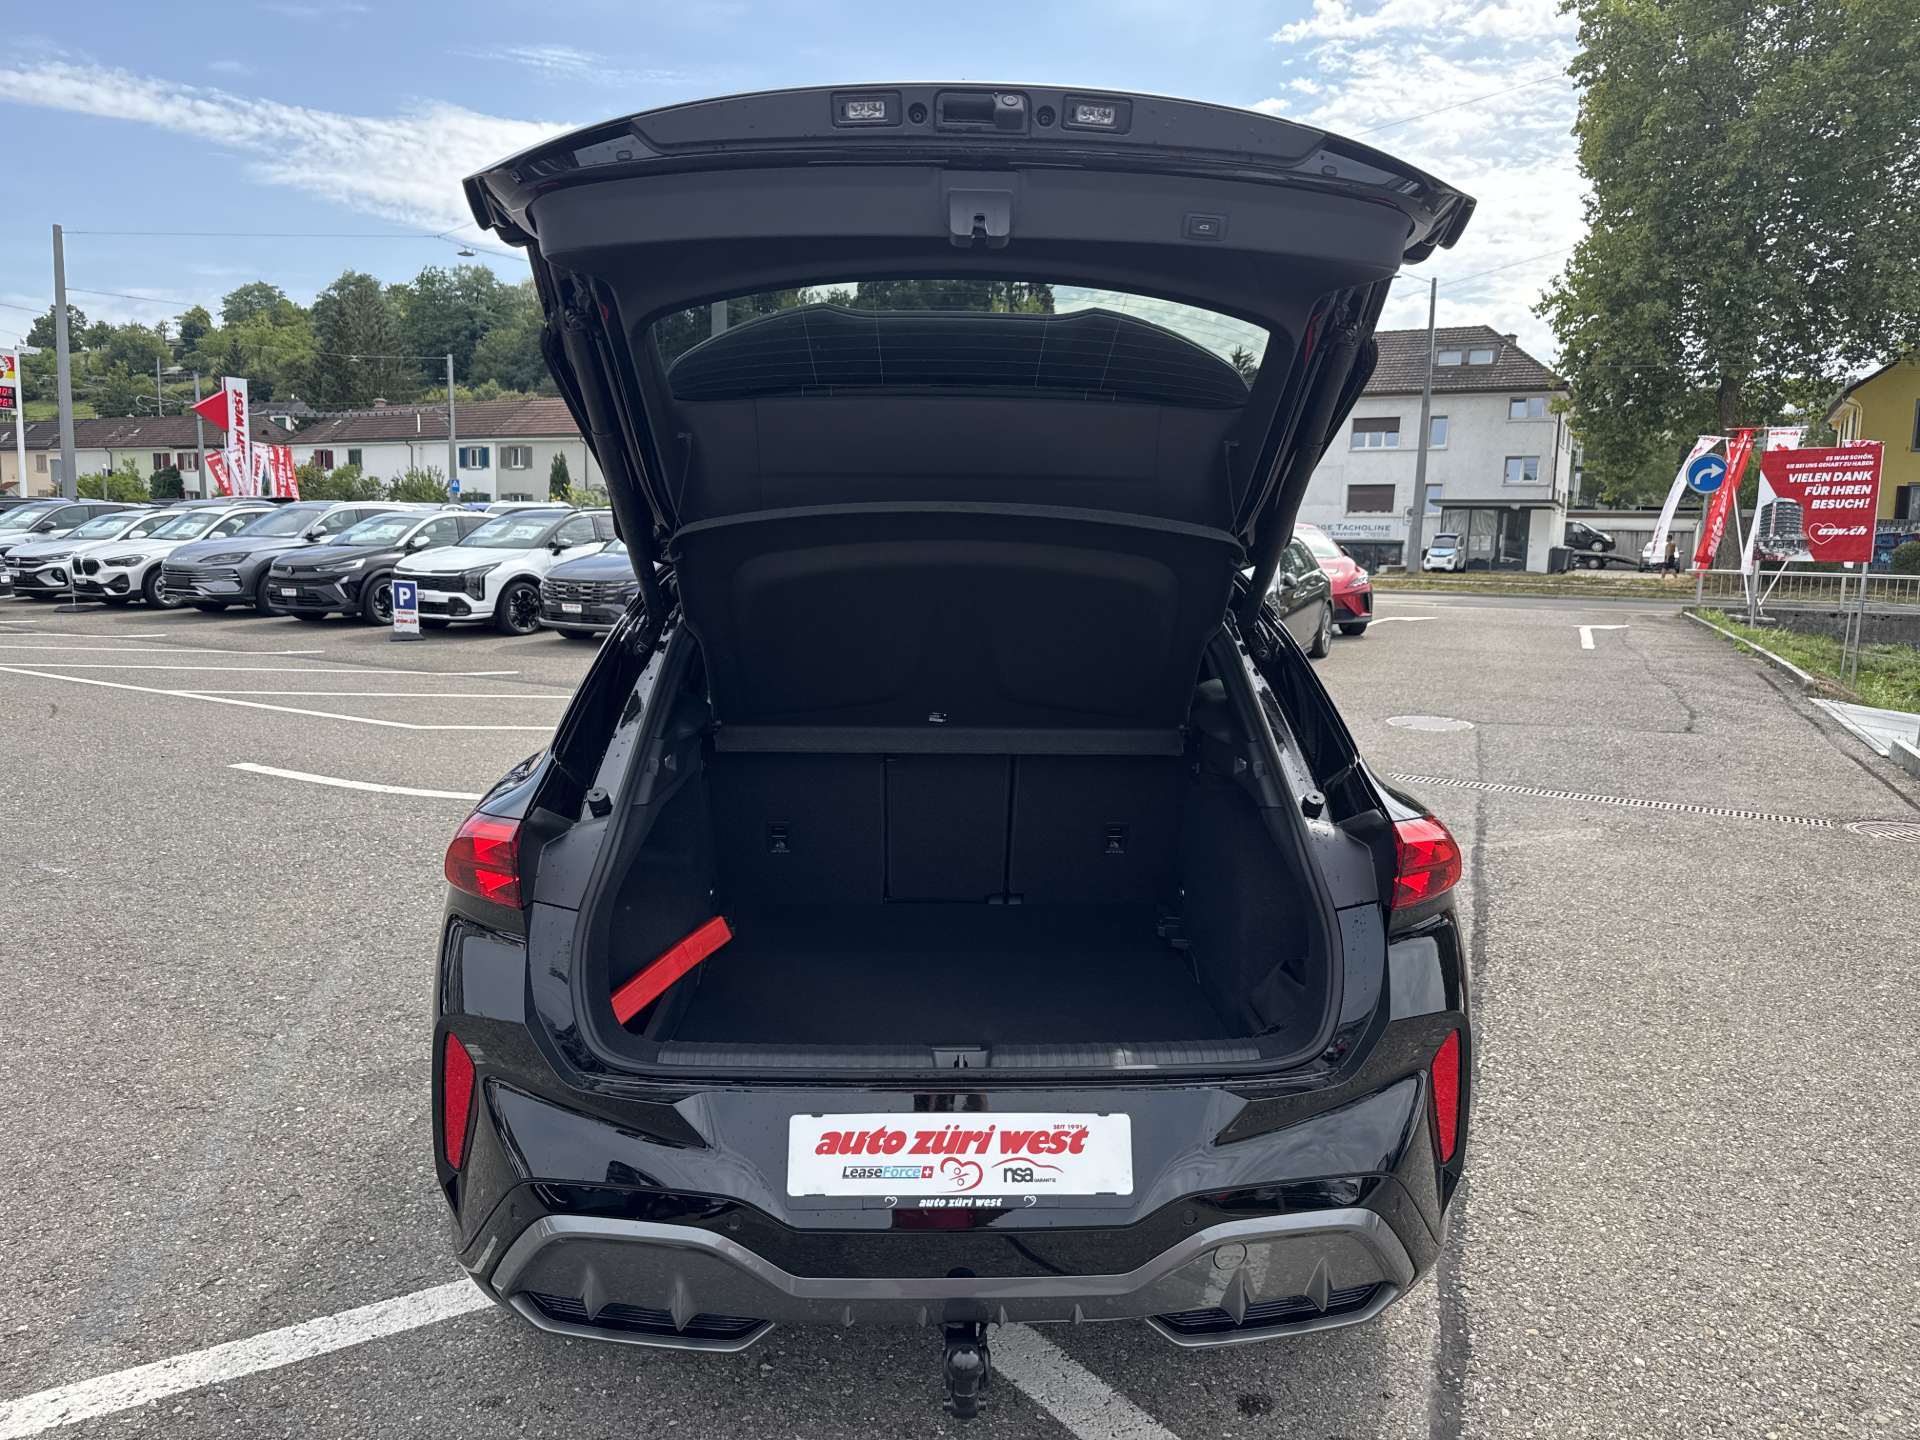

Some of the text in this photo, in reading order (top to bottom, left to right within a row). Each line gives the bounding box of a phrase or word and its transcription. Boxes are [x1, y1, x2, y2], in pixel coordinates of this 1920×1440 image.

[233, 389, 245, 427] west
[1788, 471, 1874, 483] VIELEN DANK
[1804, 484, 1872, 496] FÜR IHREN
[1811, 498, 1871, 509] BESUCH!
[1707, 516, 1724, 558] auto
[399, 587, 411, 606] P
[815, 1124, 1089, 1155] auto züri west
[842, 1166, 920, 1179] LeaseForce
[1003, 1167, 1034, 1183] nsa
[919, 1197, 1002, 1207] auto züri west
